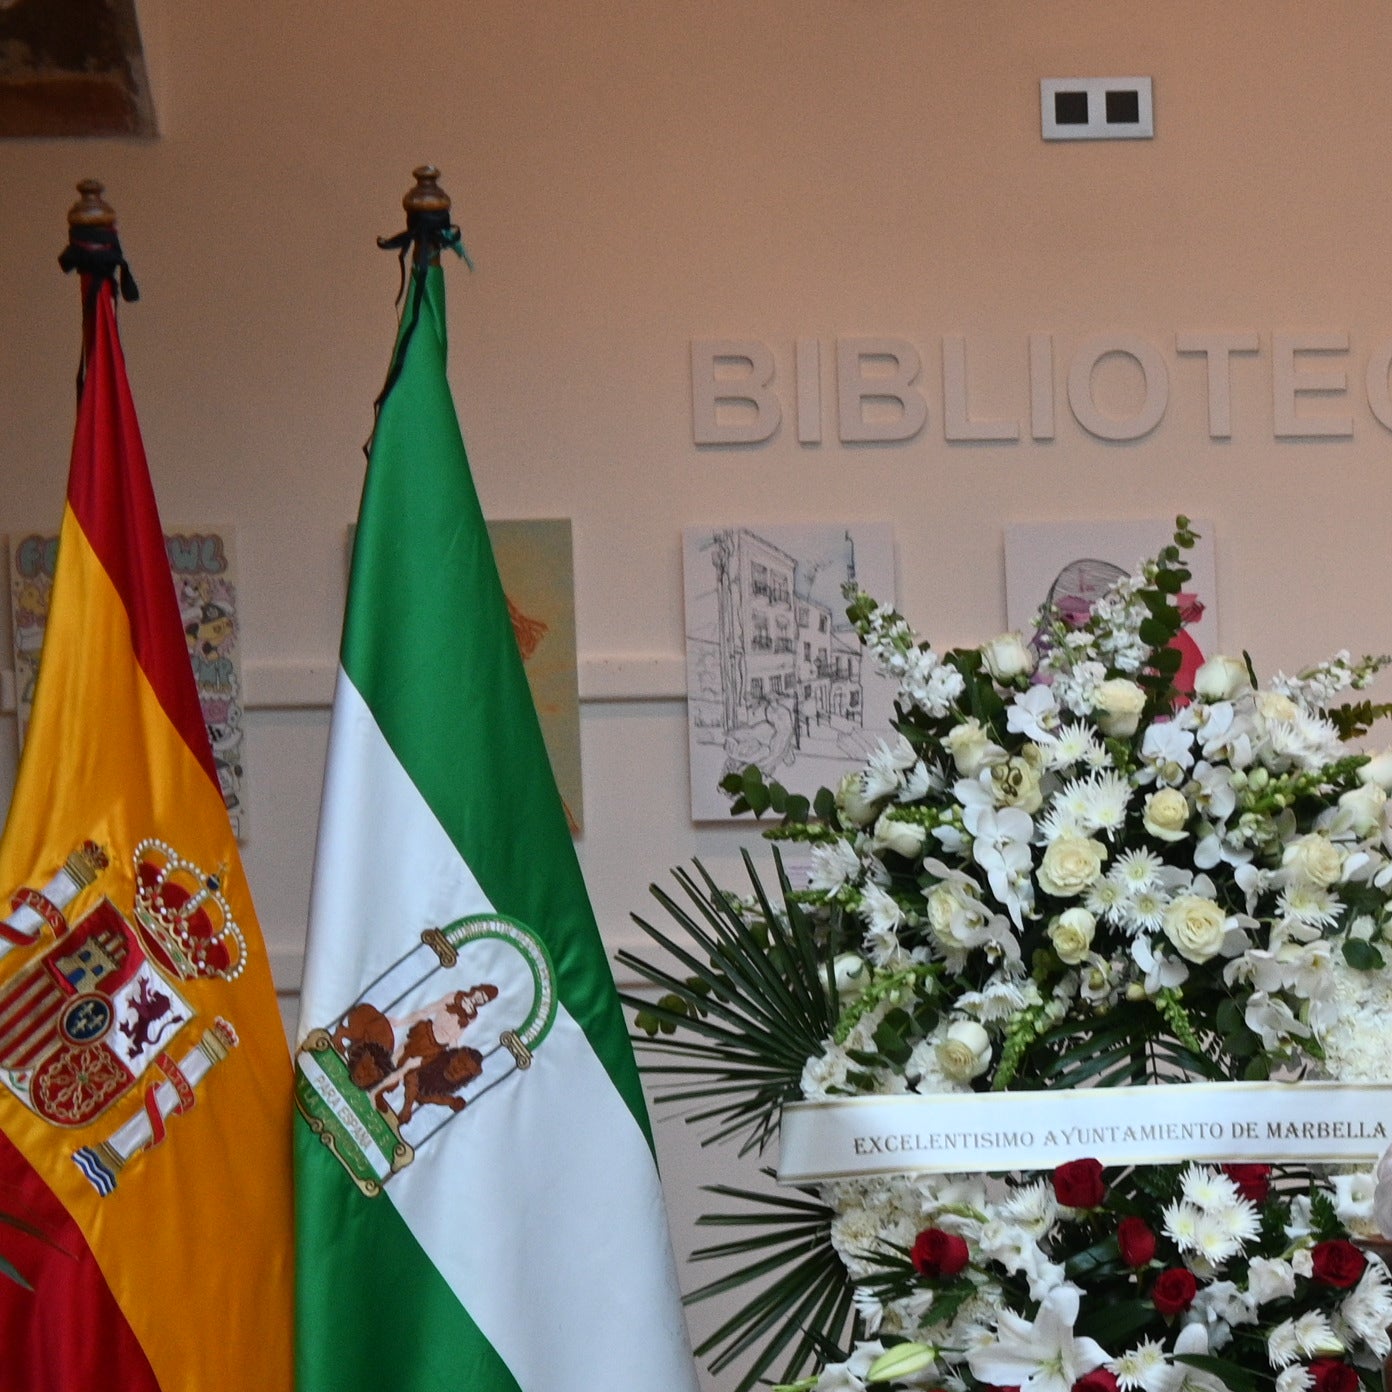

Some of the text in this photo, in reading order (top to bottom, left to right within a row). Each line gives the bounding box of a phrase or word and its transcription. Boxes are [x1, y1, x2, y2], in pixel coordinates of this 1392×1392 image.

[854, 1120, 1388, 1155] EXCELENTISIMO AYUNTAMIENTO DE MARBELLA
